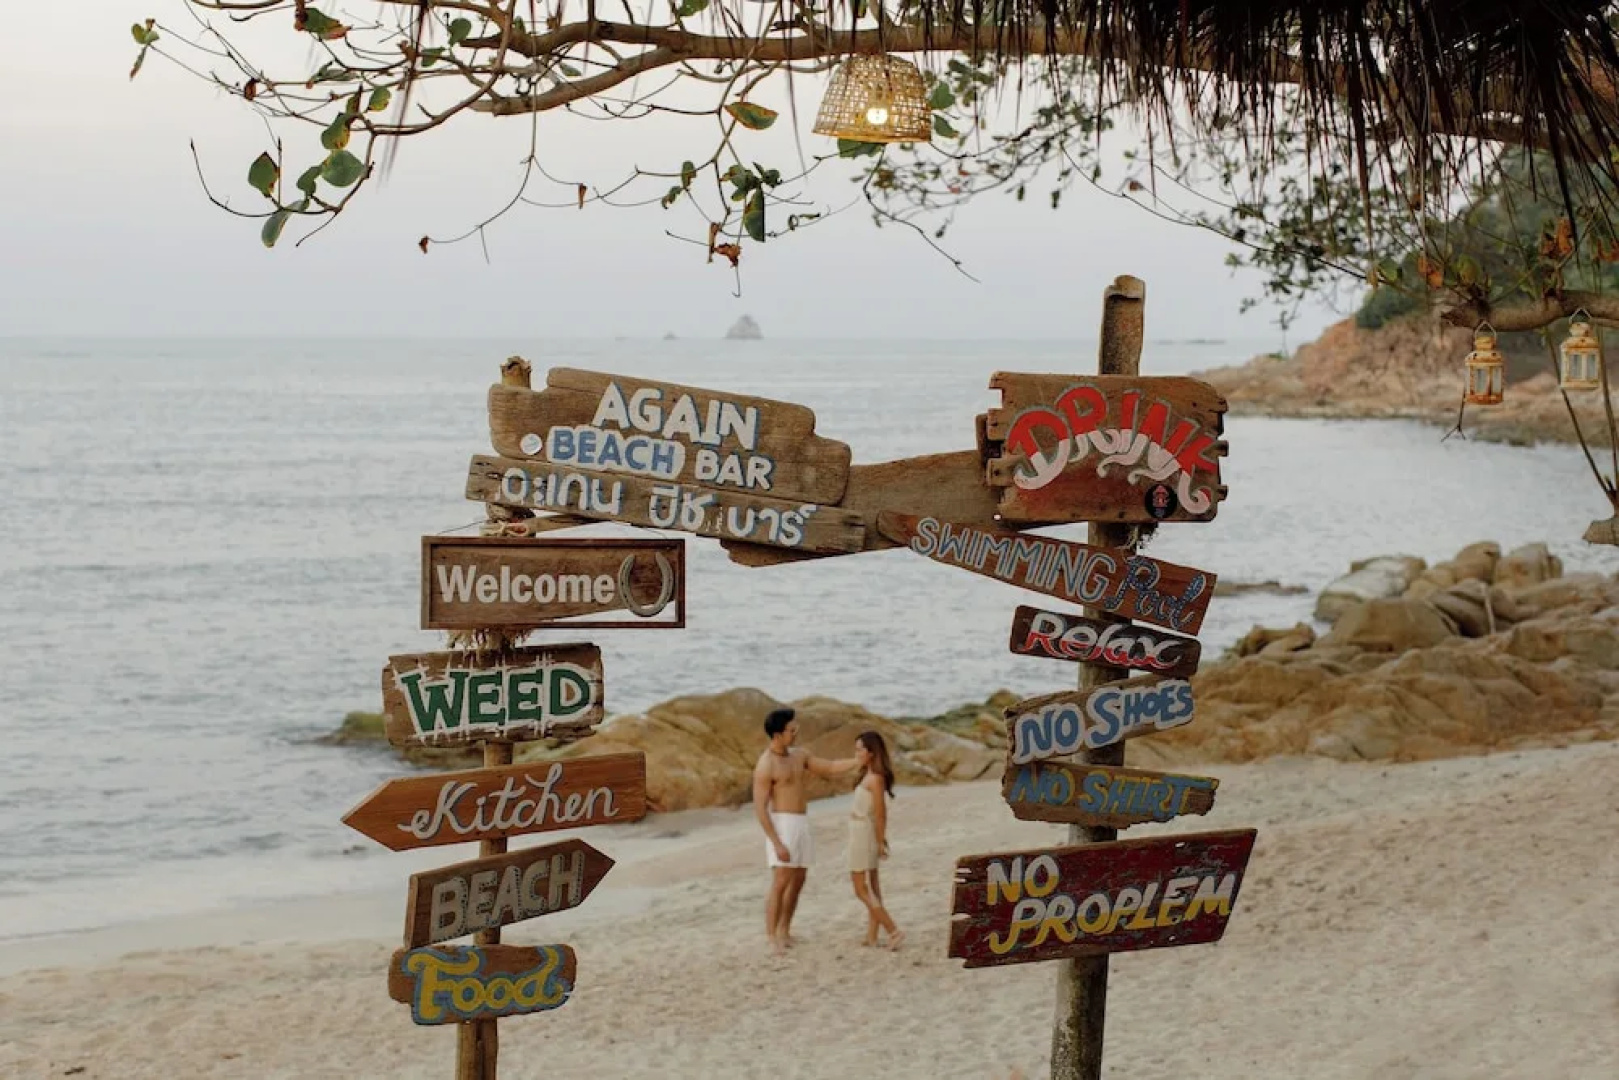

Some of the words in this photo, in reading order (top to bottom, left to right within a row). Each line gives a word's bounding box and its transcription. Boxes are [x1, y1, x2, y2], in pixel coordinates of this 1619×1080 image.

[592, 382, 758, 450] AGAIN
[1007, 385, 1218, 515] DRINK
[547, 426, 686, 478] BEACH
[694, 449, 775, 490] BAR
[436, 564, 616, 604] Welcome
[910, 517, 1116, 602] SWIMMING
[1024, 610, 1185, 670] Relax
[400, 668, 592, 733] WEED
[1016, 704, 1083, 762] NO
[1086, 680, 1194, 747] SHOES
[397, 763, 619, 840] Kitchen
[1010, 768, 1074, 805] NO
[1079, 769, 1218, 817] SHIRT
[430, 851, 585, 942] BEACH
[985, 874, 1234, 954] PROPLEM
[986, 855, 1060, 905] NO
[406, 947, 564, 1021] Food
